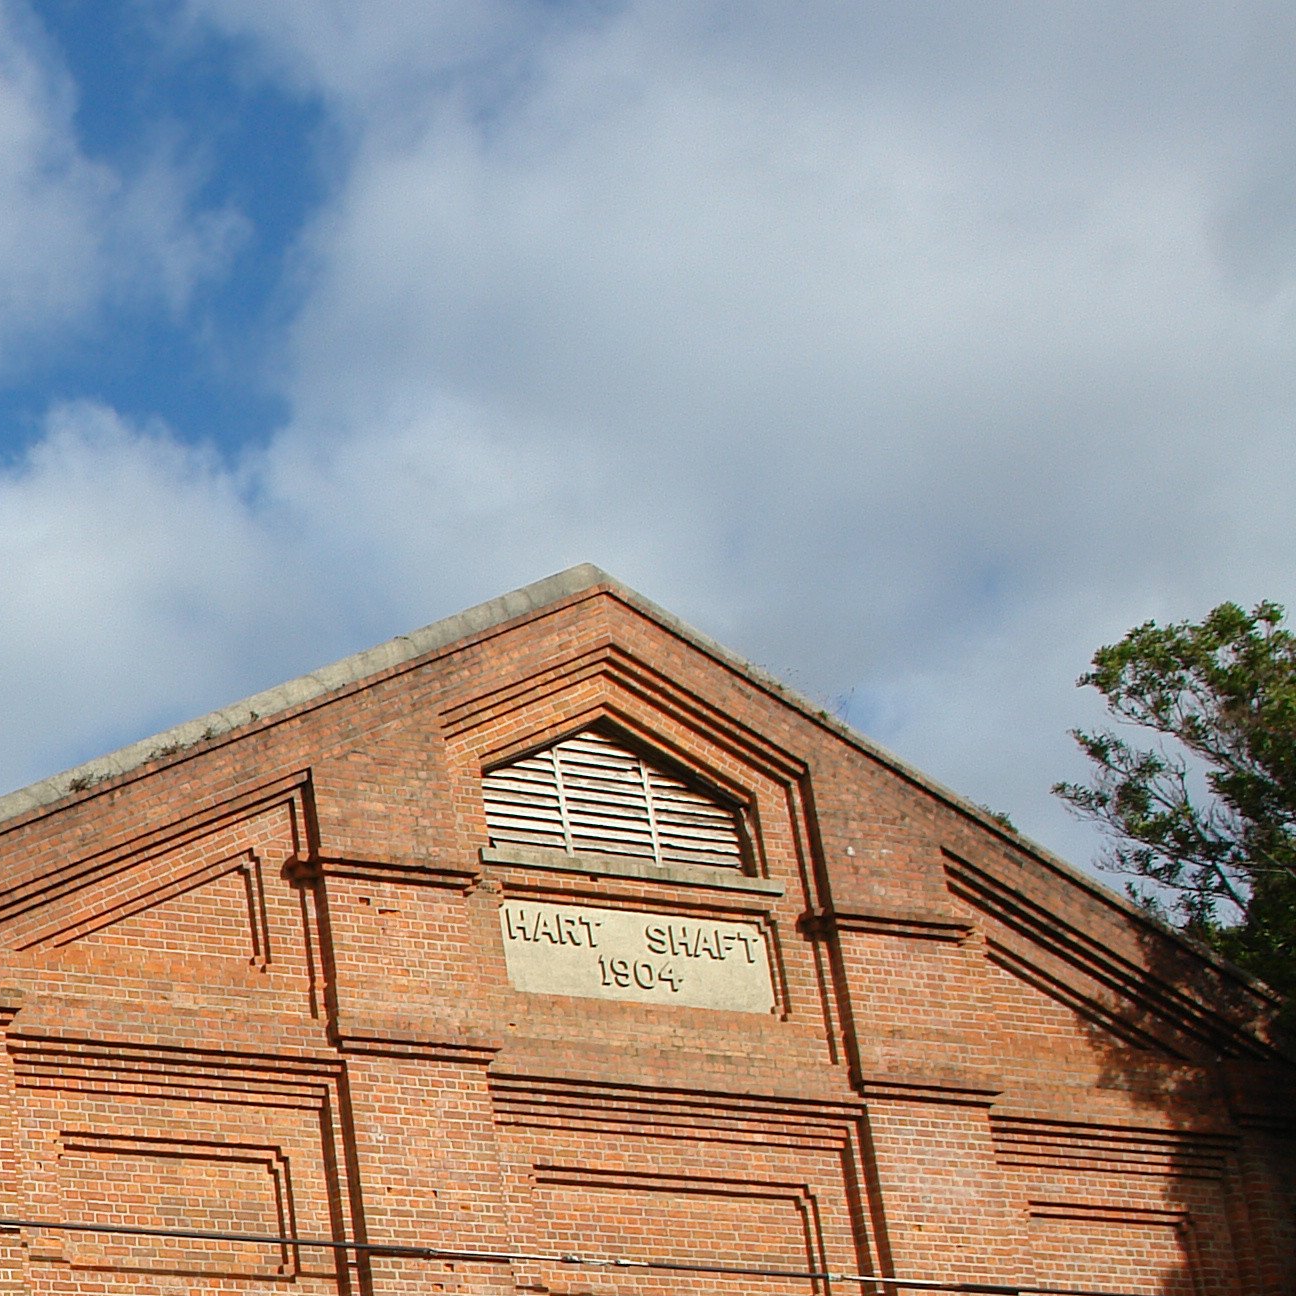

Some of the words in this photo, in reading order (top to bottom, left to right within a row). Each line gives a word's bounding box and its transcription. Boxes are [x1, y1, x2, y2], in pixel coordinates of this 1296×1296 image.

[505, 908, 602, 948] HART
[645, 923, 758, 964] SHAFT
[598, 954, 684, 993] 1904
